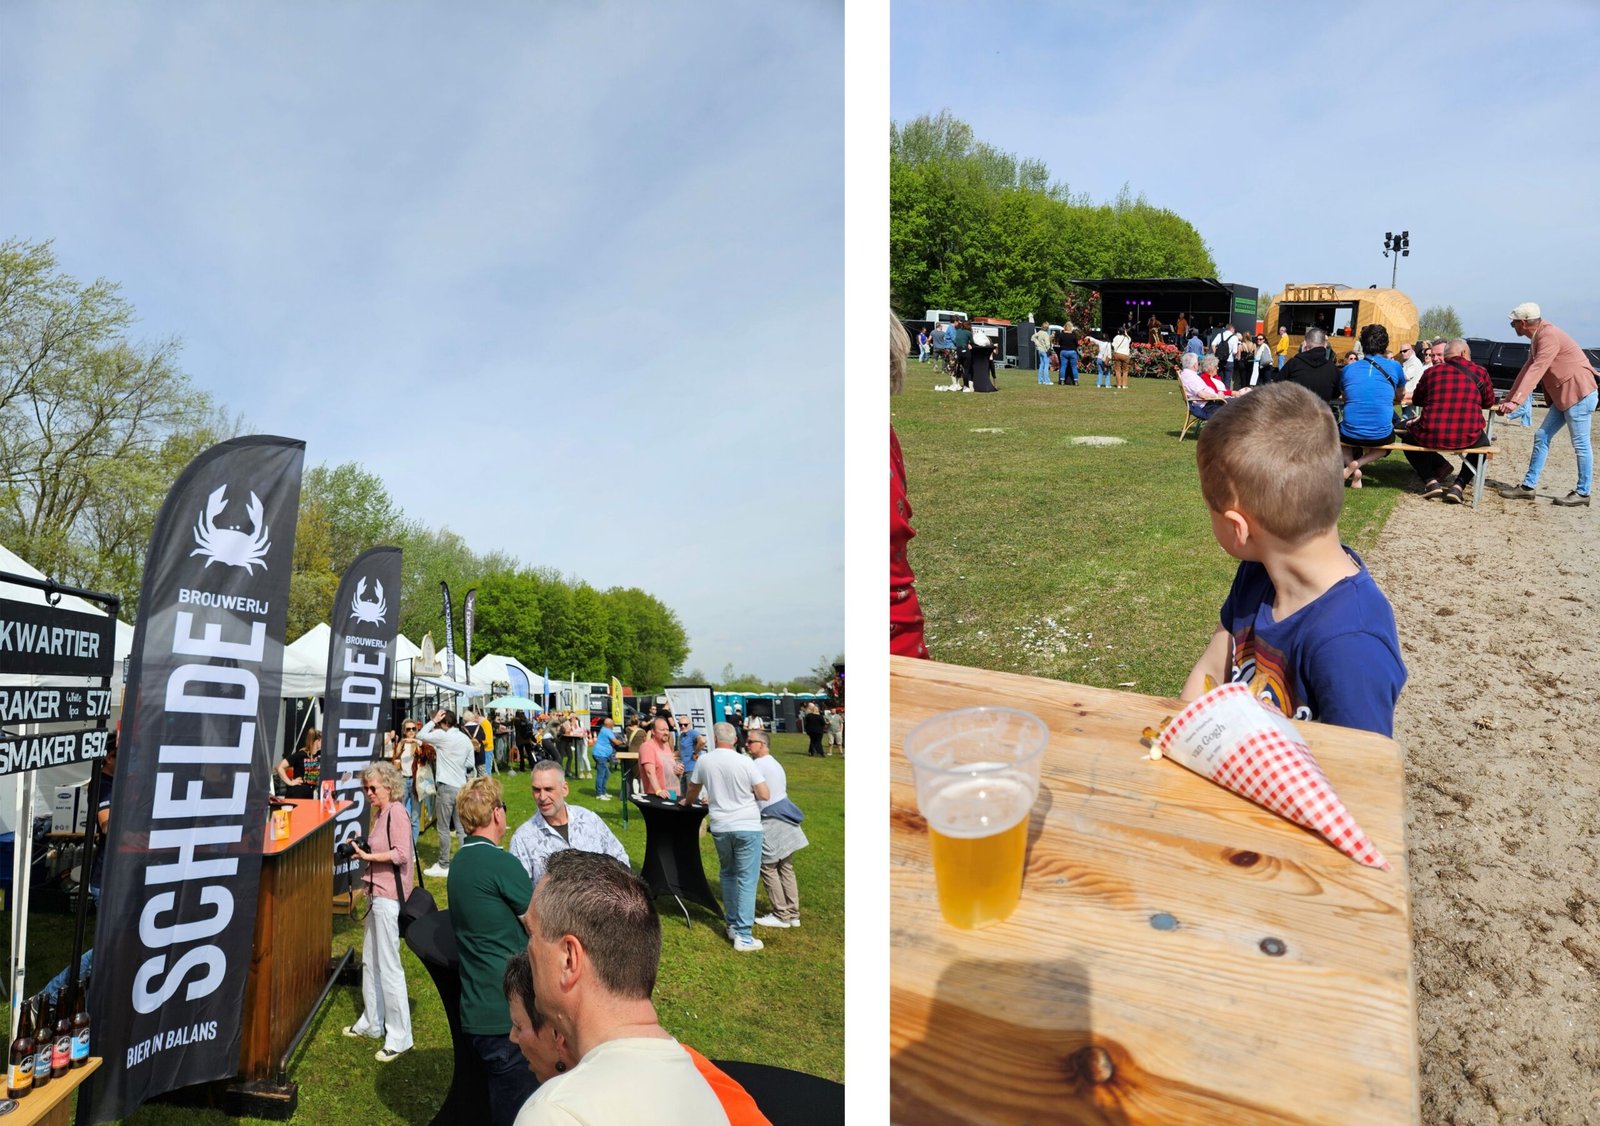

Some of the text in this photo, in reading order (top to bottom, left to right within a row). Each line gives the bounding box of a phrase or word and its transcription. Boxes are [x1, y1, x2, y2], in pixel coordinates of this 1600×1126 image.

[178, 588, 269, 615] BROUWERIJ
[0, 620, 100, 658] KWARTIER
[345, 635, 387, 649] BROUWERIJ
[1201, 723, 1226, 746] Gogh
[132, 611, 267, 1015] SCHELDE
[342, 859, 360, 873] BAANS
[126, 1020, 218, 1069] BIER IN BALANS
